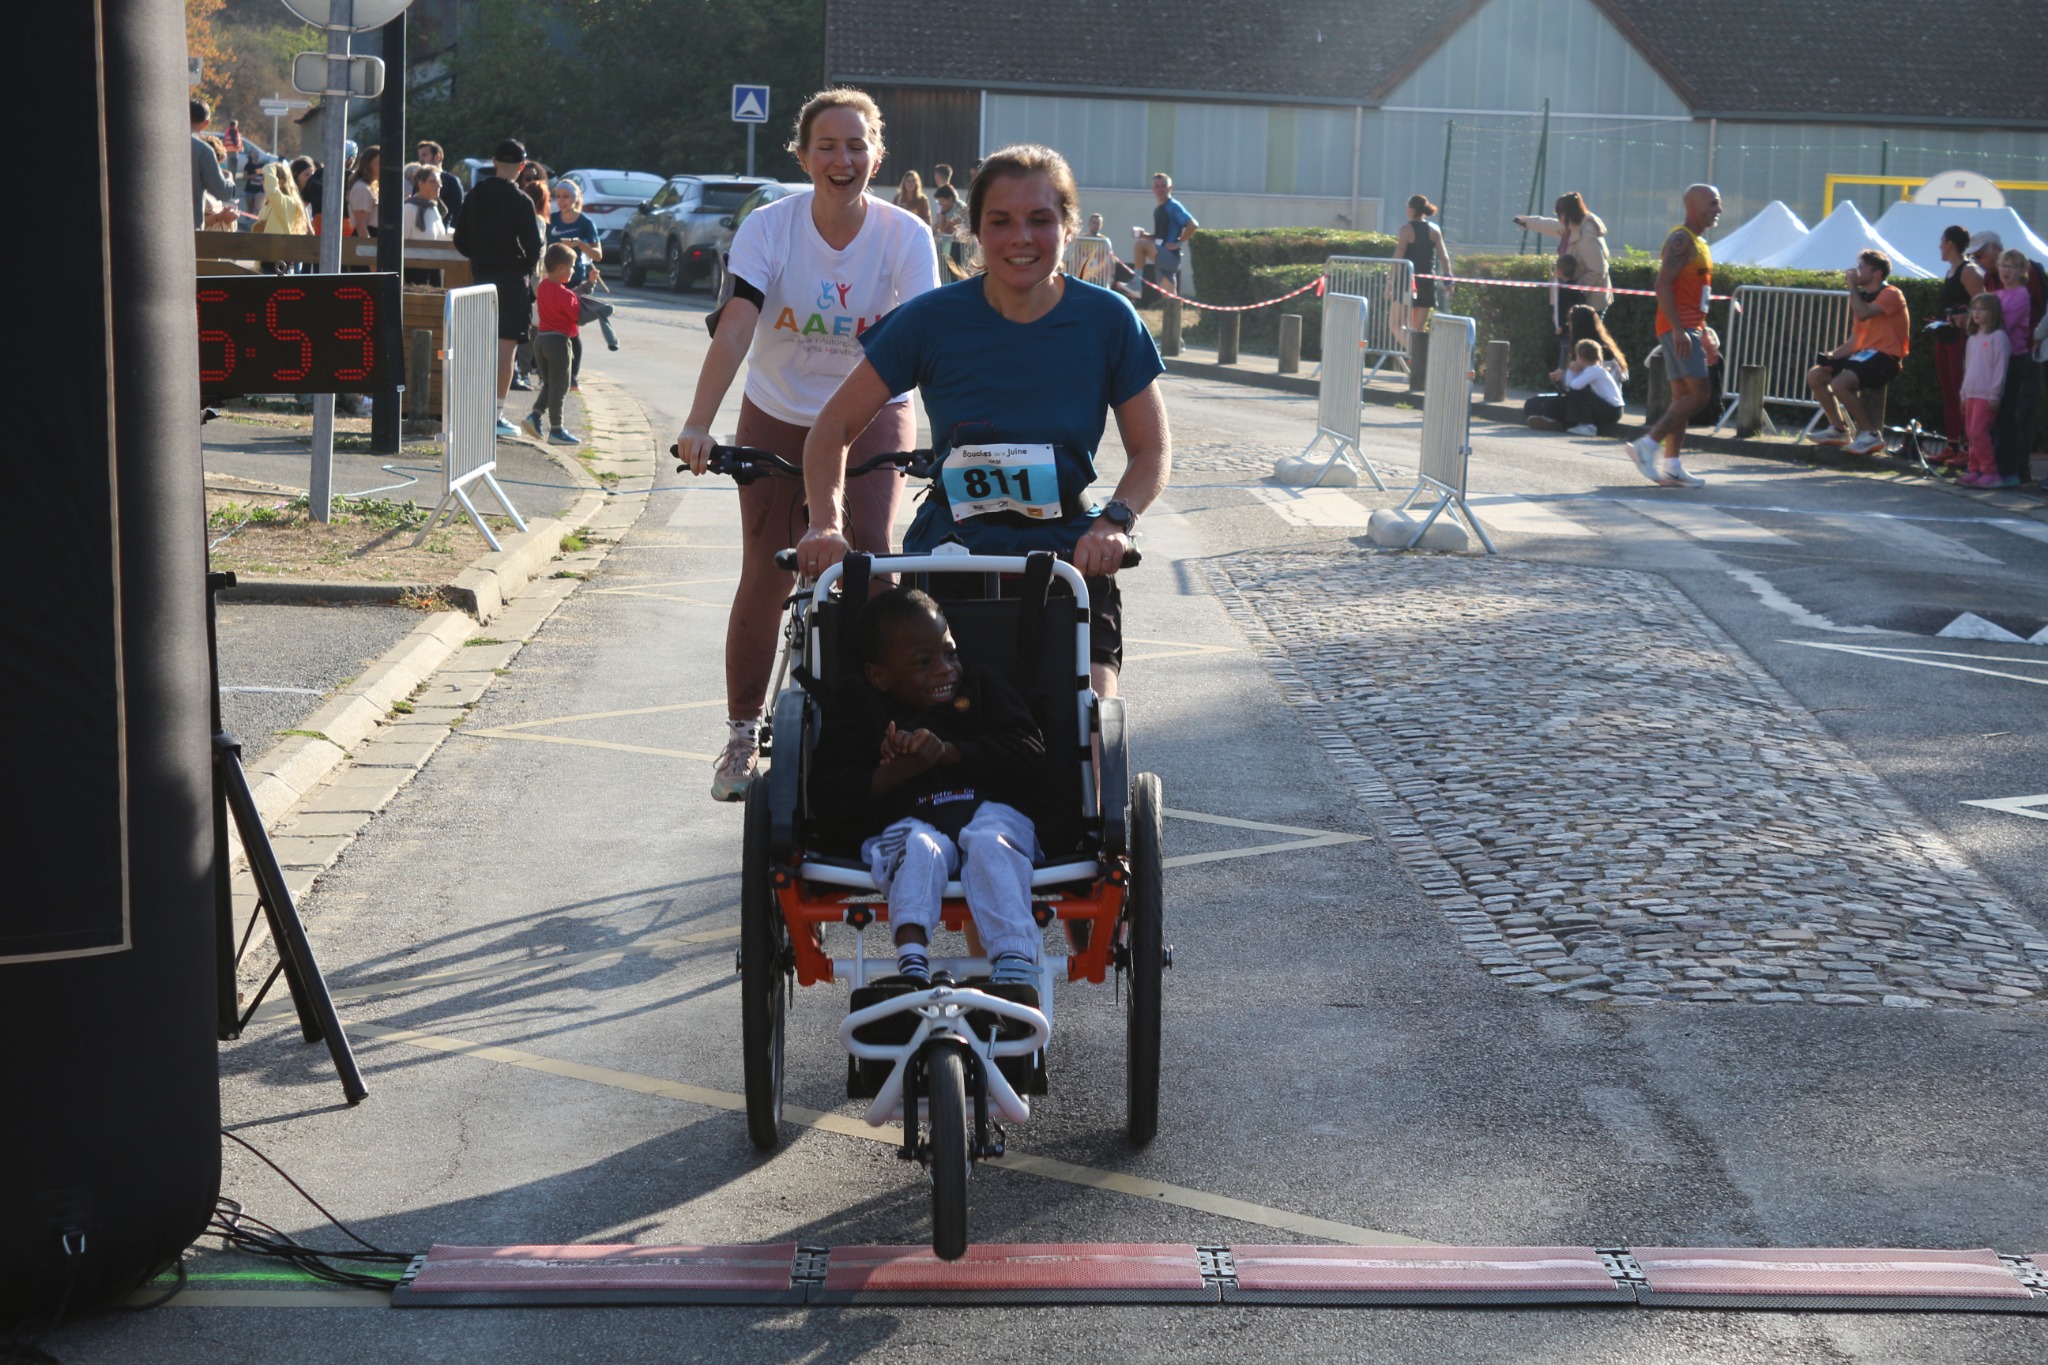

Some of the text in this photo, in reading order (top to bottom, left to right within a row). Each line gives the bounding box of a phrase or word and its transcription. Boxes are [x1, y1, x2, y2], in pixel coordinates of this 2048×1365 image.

[962, 450, 992, 458] Boucles
[1006, 448, 1028, 457] Juine
[963, 468, 1032, 501] 811
